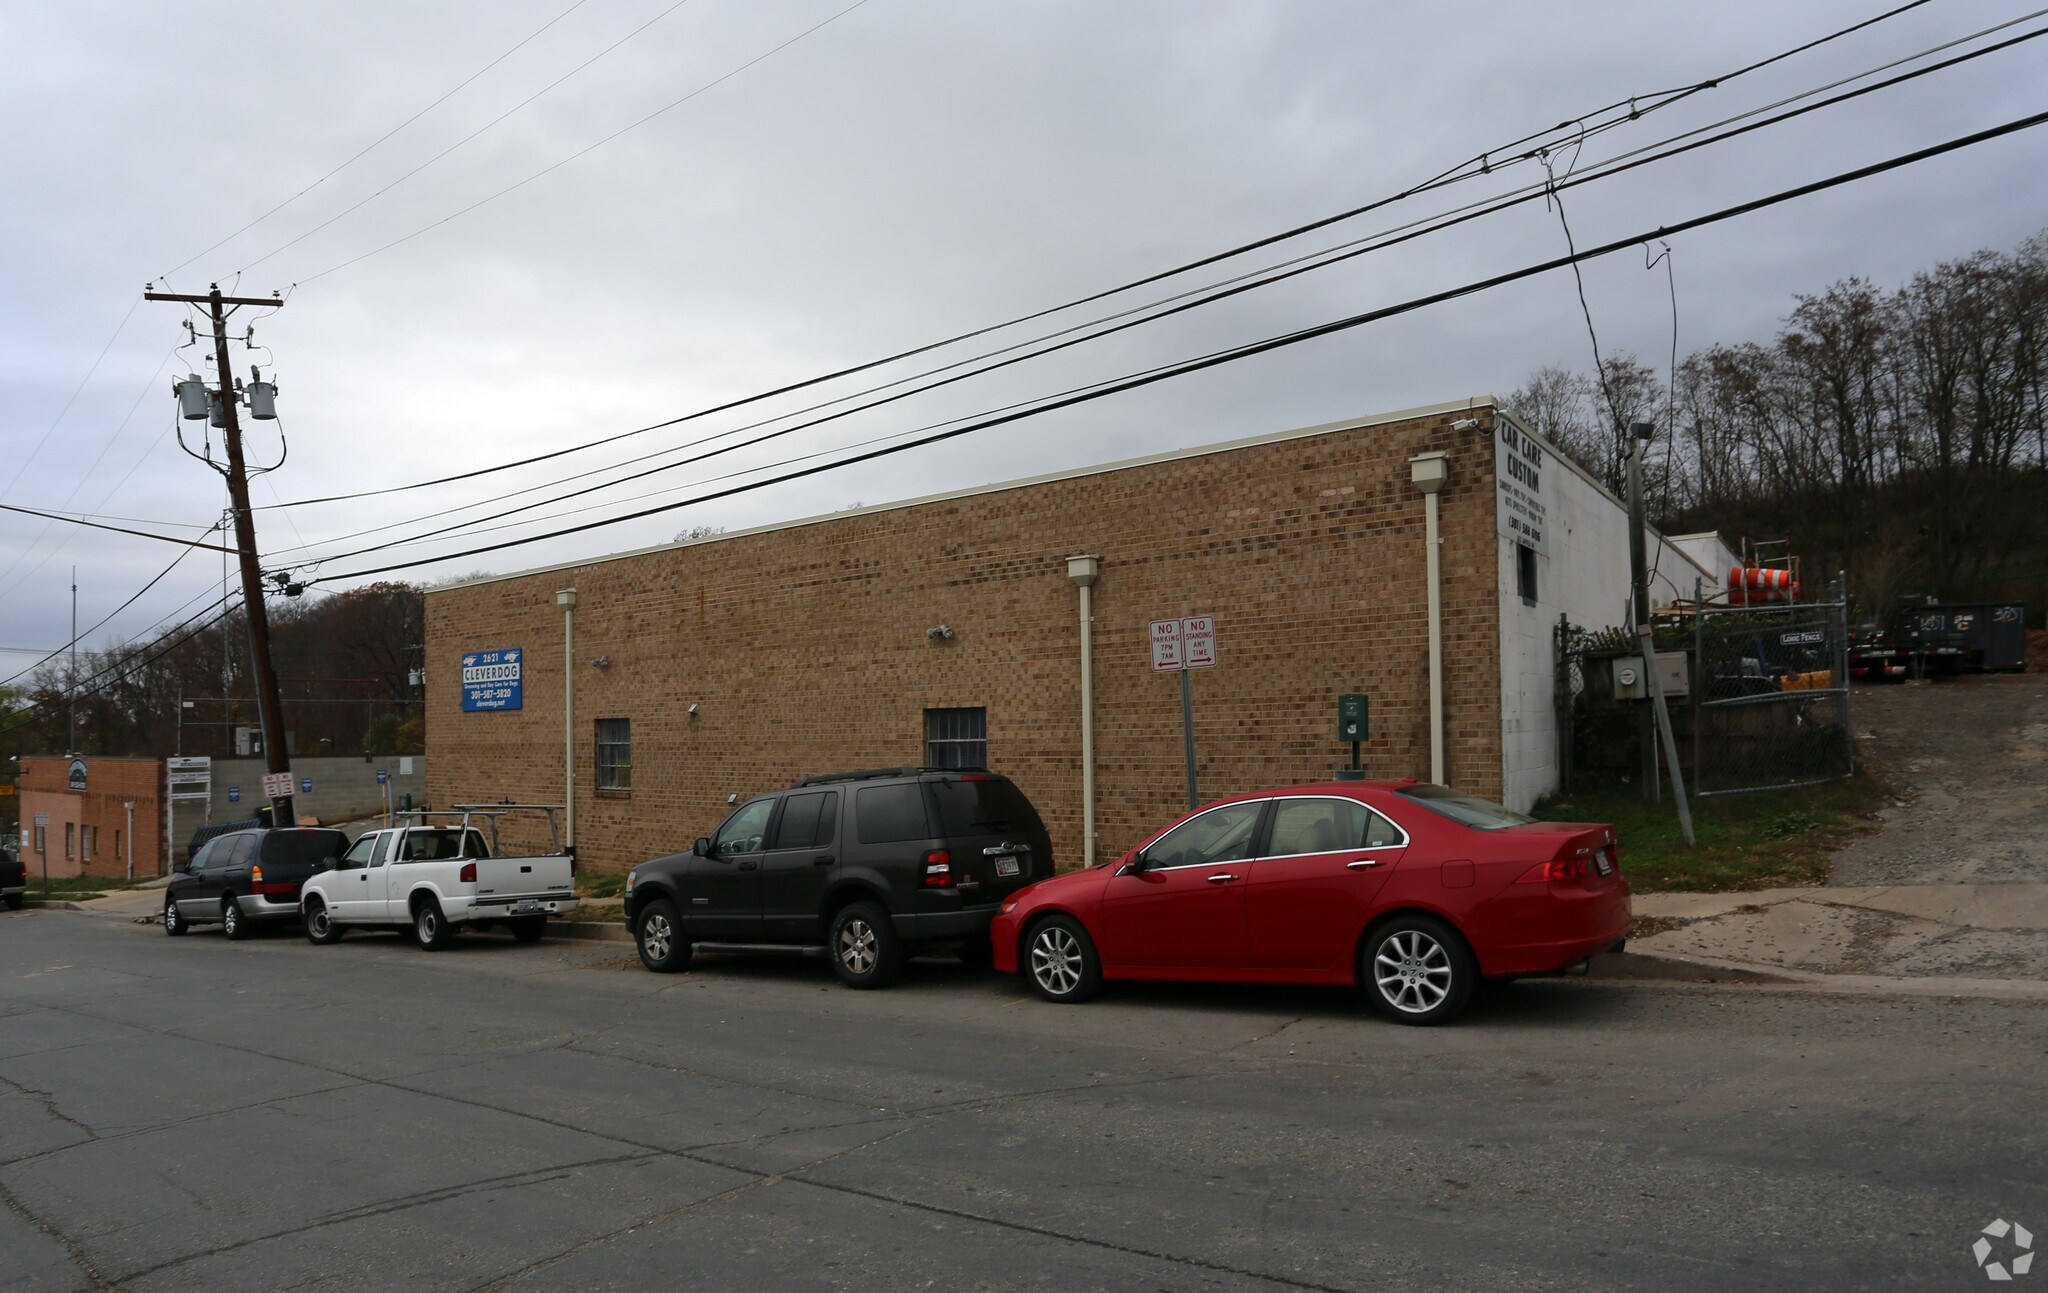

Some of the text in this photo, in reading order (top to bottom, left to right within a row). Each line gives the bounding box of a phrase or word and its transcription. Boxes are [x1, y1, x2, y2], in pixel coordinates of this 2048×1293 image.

[1501, 421, 1542, 469] CAR CARE
[1508, 453, 1540, 494] CUSTOM
[1158, 624, 1172, 634] NO
[1191, 621, 1205, 631] NO
[1153, 635, 1179, 643] PARKING
[1186, 632, 1212, 640] STANDING
[483, 653, 499, 663] 2621
[465, 665, 517, 681] CLEVERDOG
